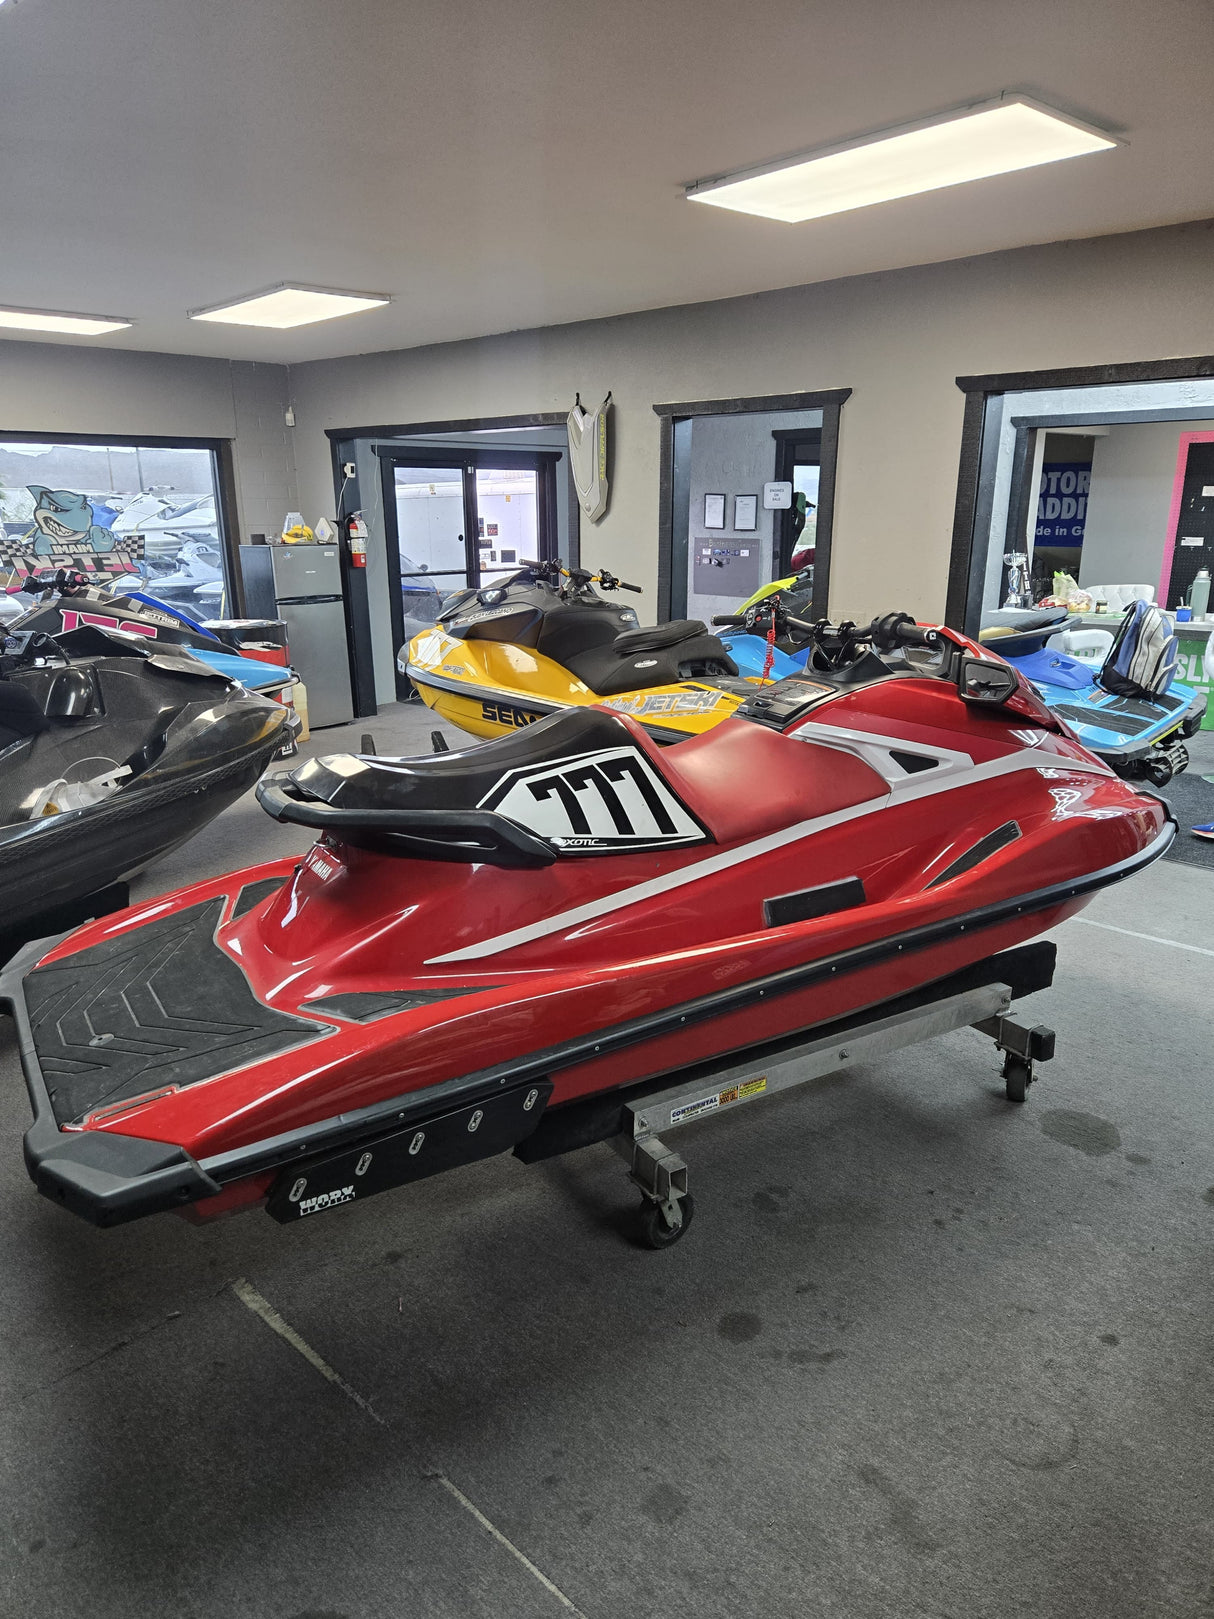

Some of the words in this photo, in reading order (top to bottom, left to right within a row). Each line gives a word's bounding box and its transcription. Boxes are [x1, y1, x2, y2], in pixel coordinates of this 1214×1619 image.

[1055, 526, 1067, 536] in
[637, 690, 723, 717] JETSKI
[526, 755, 678, 836] 777
[671, 1096, 719, 1118] CONTINENTAL
